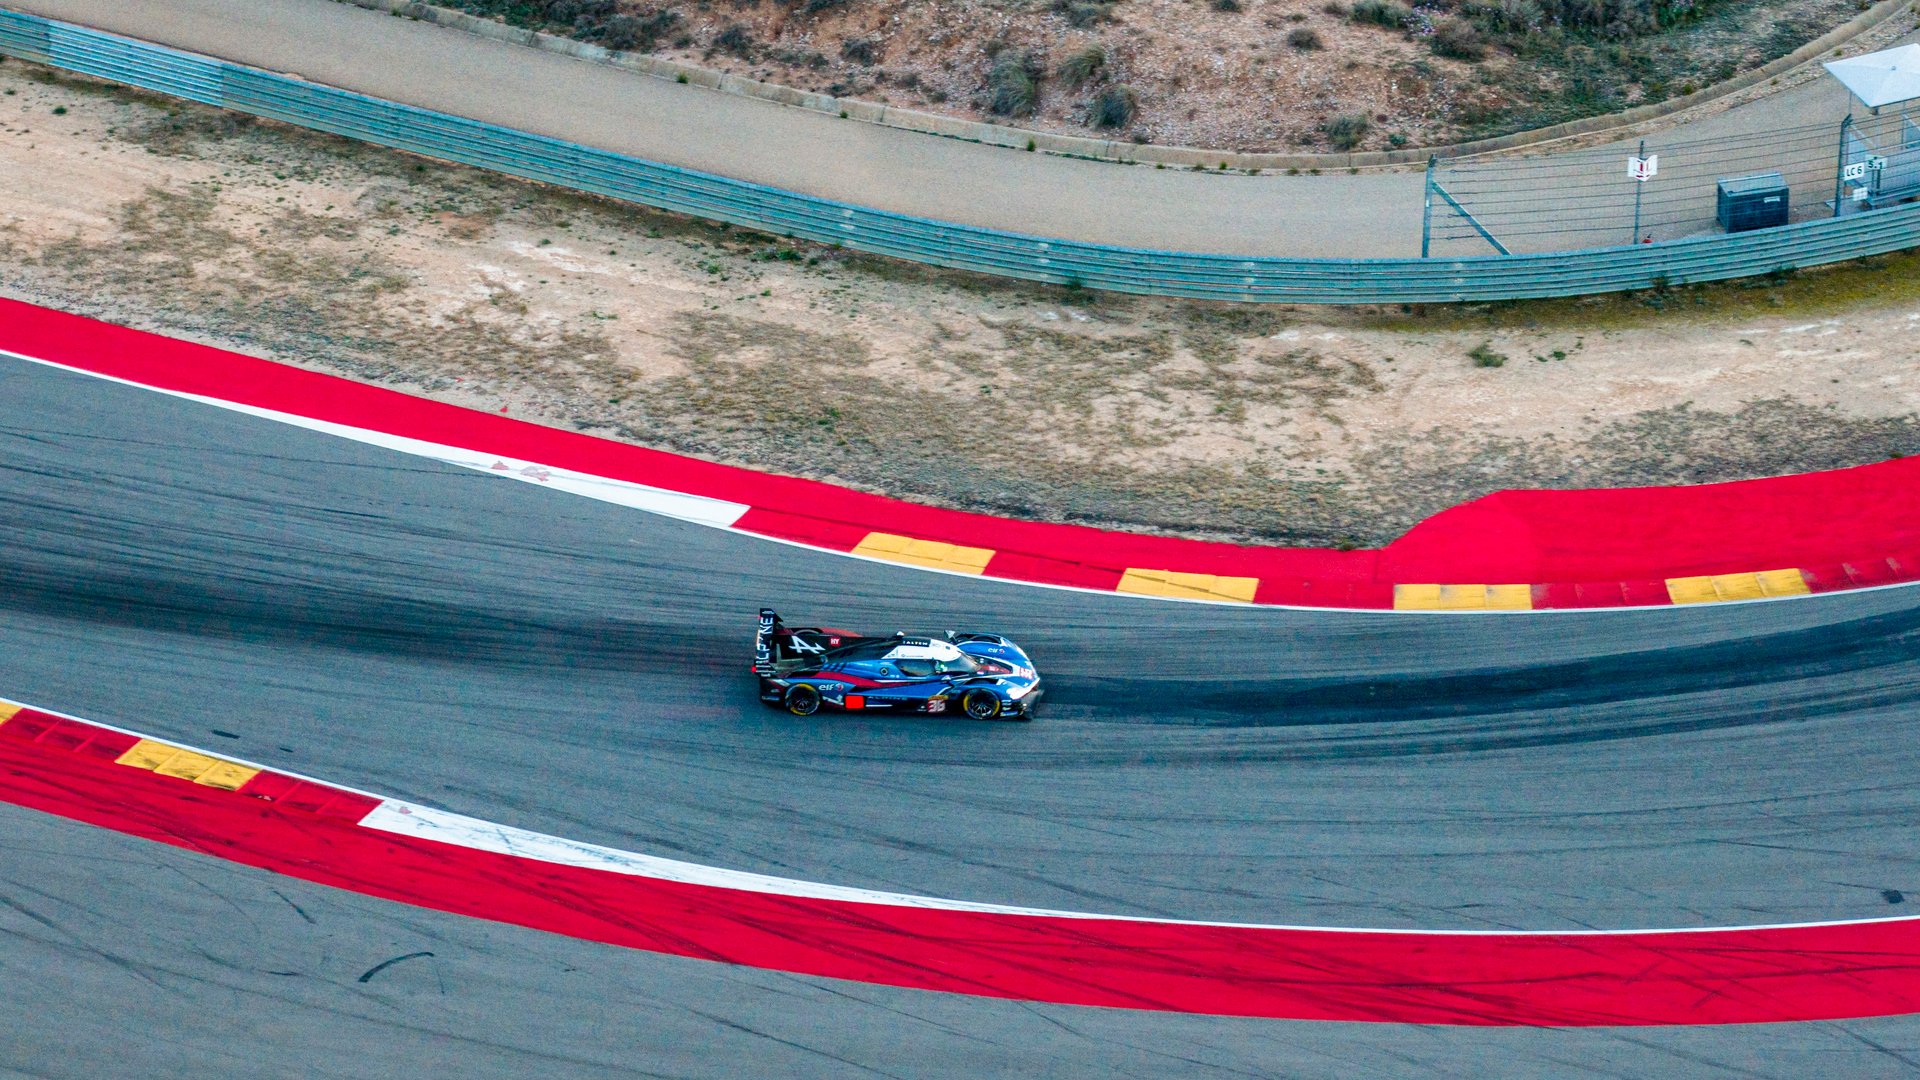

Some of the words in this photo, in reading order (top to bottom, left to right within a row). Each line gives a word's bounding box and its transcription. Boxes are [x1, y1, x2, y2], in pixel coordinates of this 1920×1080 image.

[1846, 168, 1855, 177] LC
[1857, 166, 1863, 174] 6
[928, 699, 946, 712] 36
